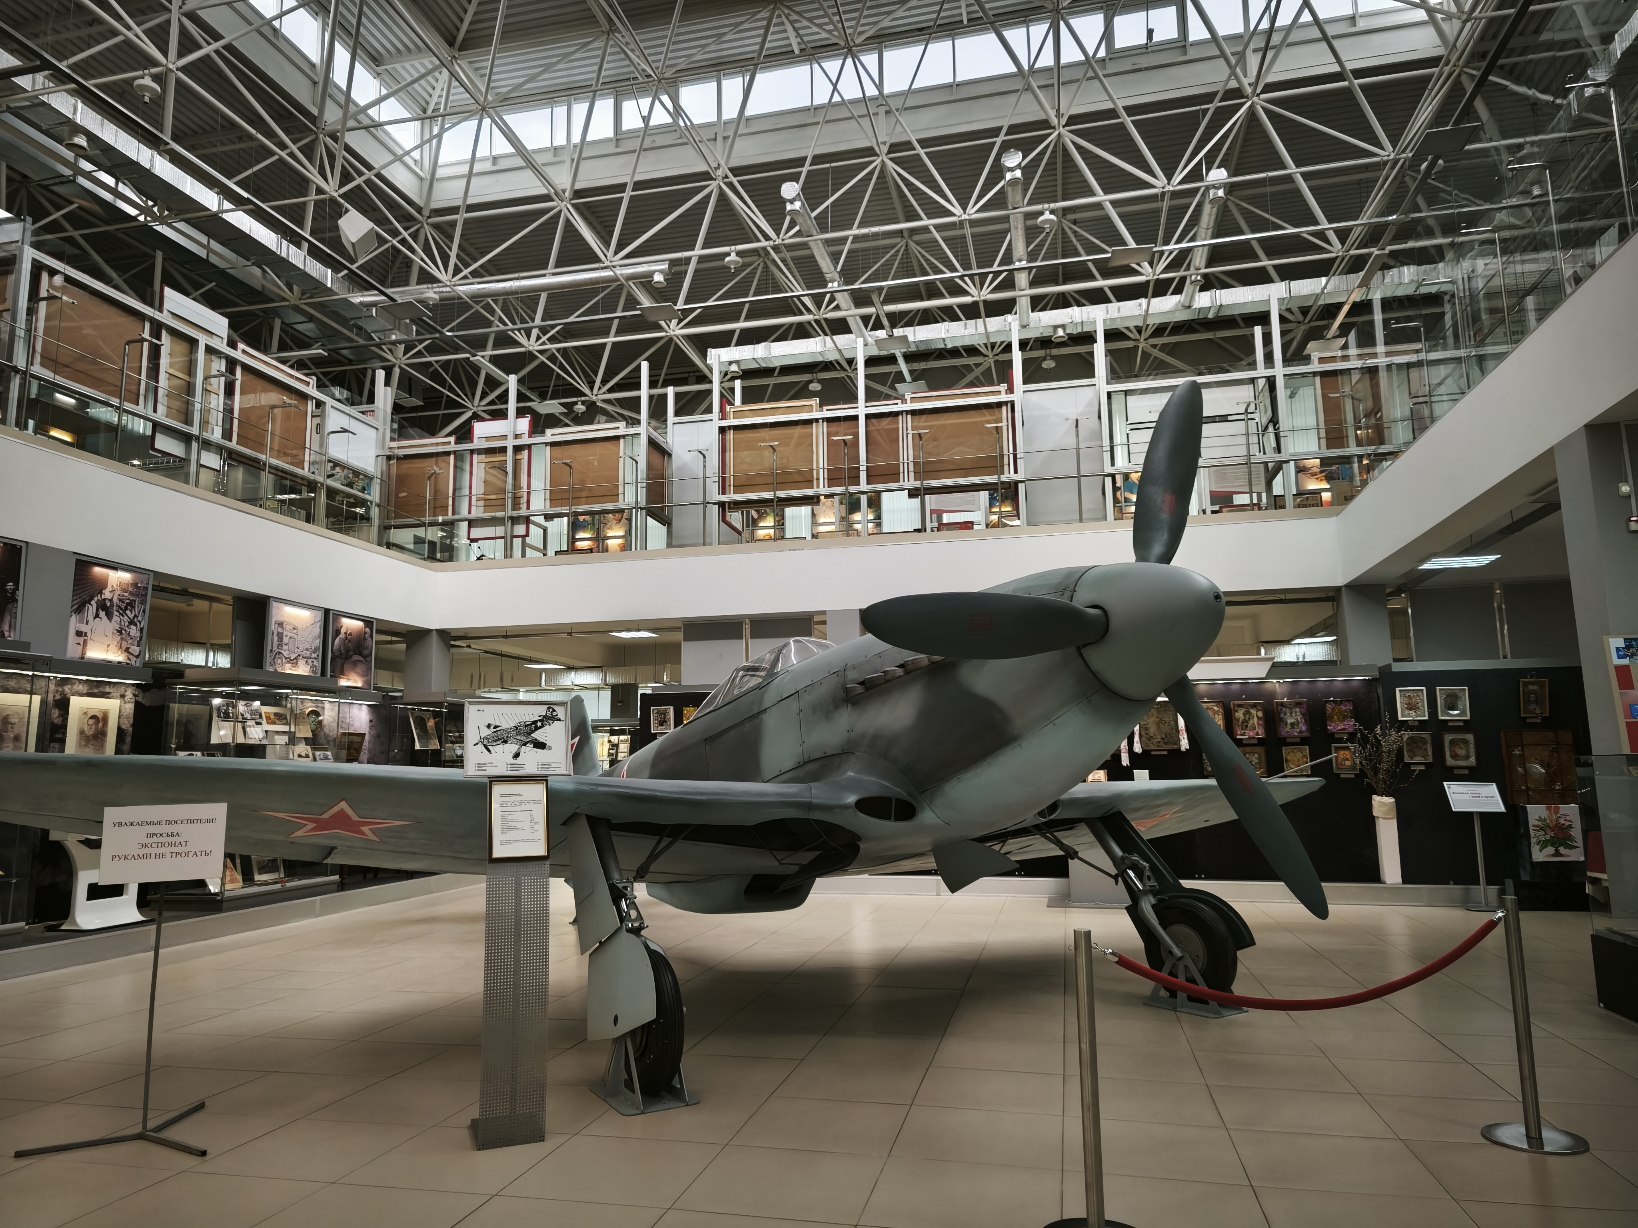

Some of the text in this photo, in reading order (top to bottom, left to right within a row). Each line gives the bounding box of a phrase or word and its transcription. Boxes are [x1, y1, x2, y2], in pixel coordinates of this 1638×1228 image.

[112, 818, 217, 828] УВАЖАЕМЫЕ ПОСЕТИТЕЛИ!
[138, 840, 190, 850] ЭКСПОНАТ
[111, 850, 213, 862] РУКАМИ НЕ ТРОГАТЬ!
